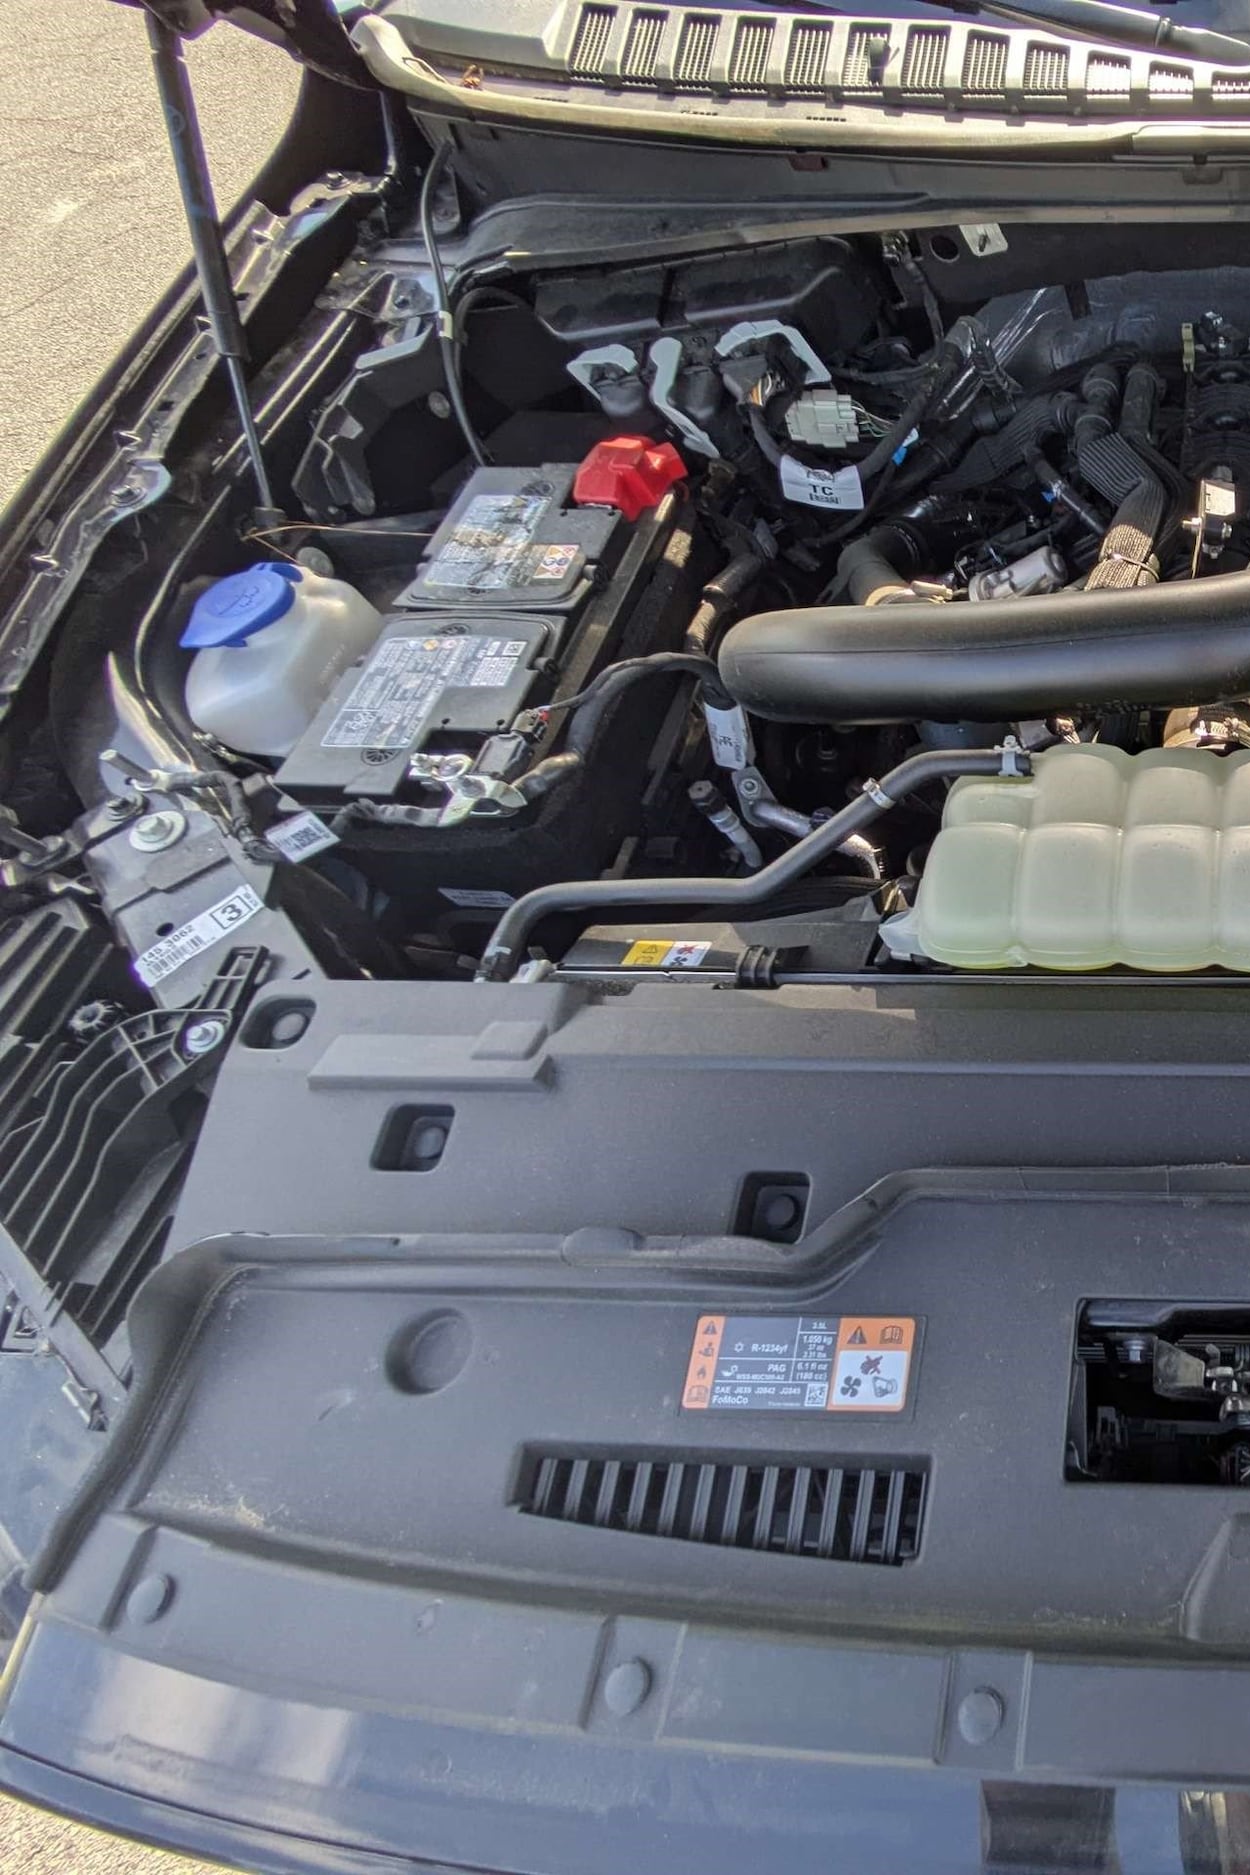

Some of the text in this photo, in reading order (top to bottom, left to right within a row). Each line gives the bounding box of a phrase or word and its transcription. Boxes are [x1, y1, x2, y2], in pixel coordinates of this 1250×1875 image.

[809, 483, 833, 496] TC
[221, 904, 242, 921] 3
[822, 1335, 833, 1346] kg
[751, 1343, 788, 1354] R-1234yf
[767, 1363, 786, 1372] PAG
[714, 1386, 731, 1394] SAE
[711, 1394, 749, 1405] FoMoCo
